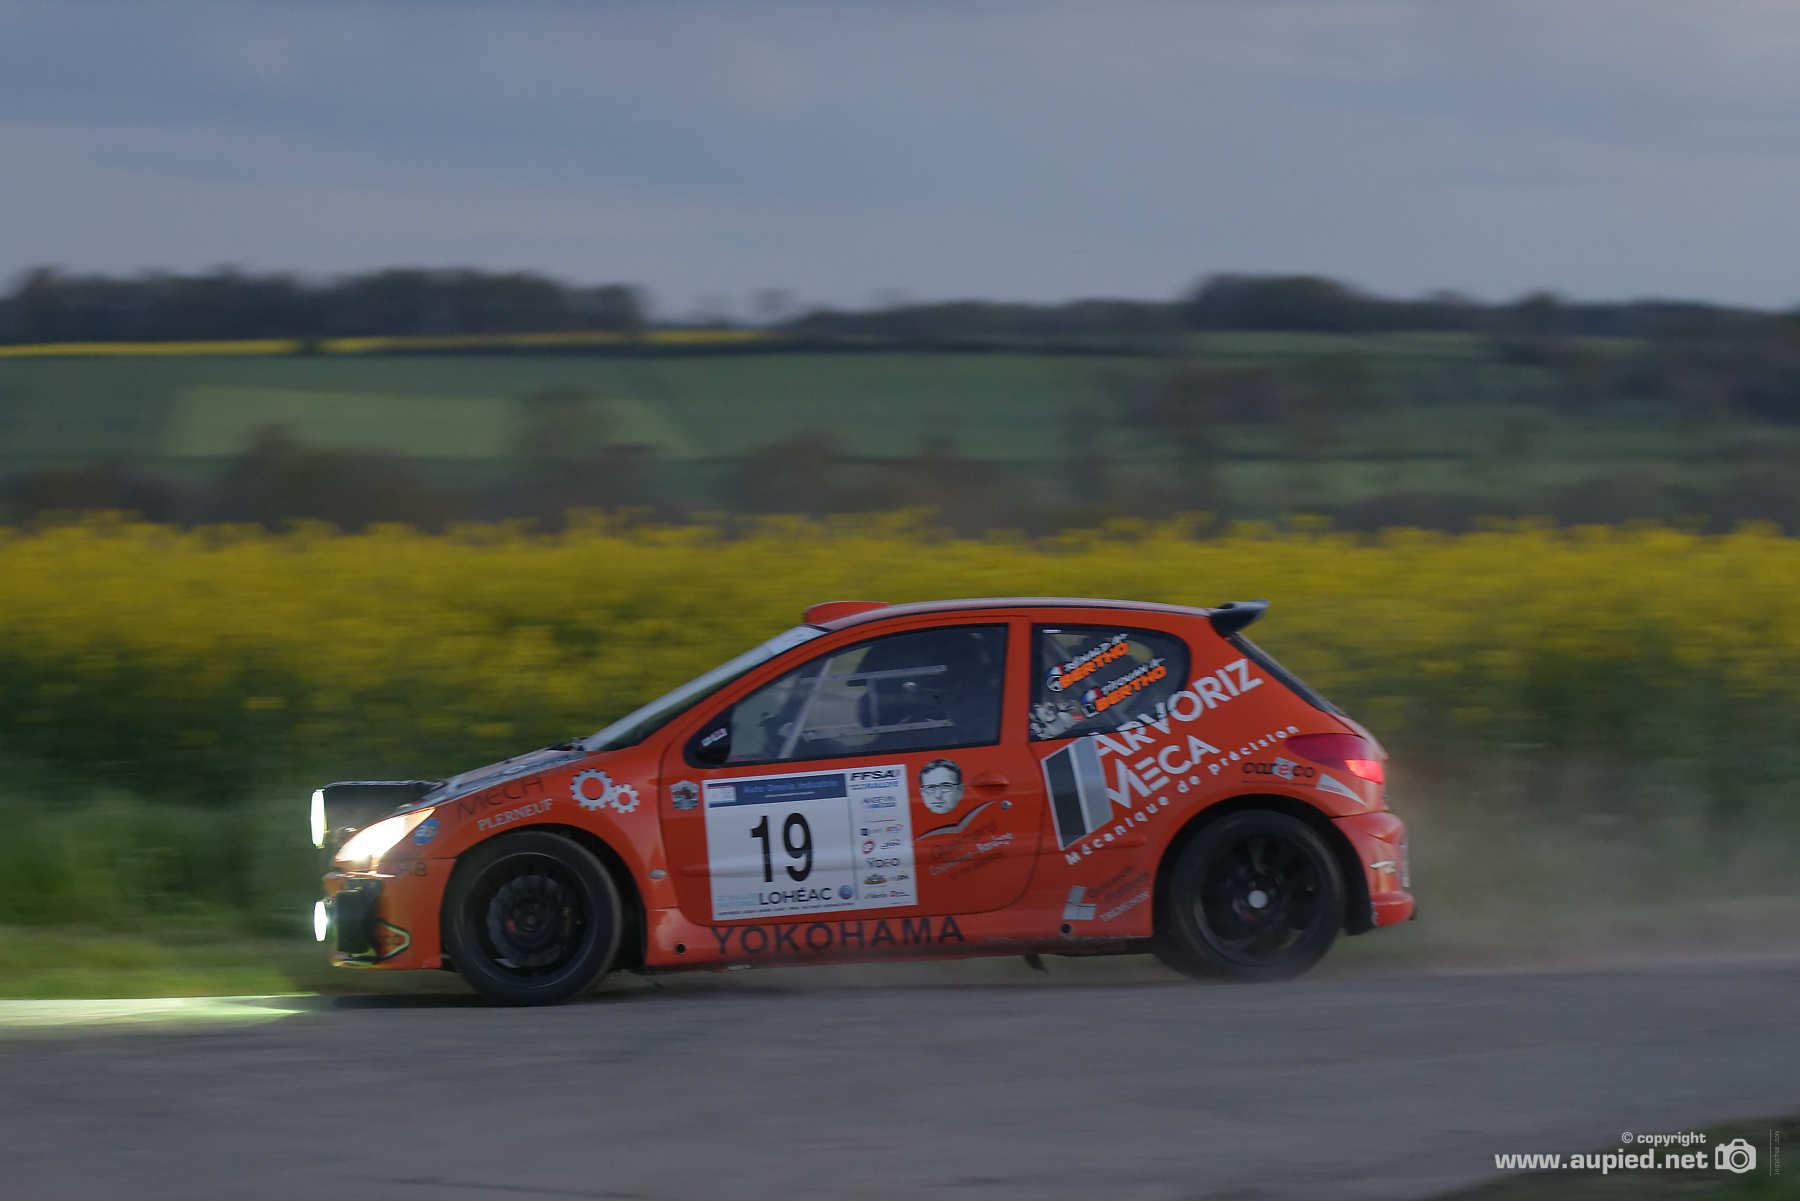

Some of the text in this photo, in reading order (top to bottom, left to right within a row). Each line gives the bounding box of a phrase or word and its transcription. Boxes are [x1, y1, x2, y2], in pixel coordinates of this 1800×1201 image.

[1058, 642, 1129, 689] BERTHO
[1094, 665, 1167, 712] BERTHO
[1087, 658, 1264, 757] ARVORIZ
[850, 769, 896, 781] FFSA
[1105, 733, 1221, 809] MECA
[476, 798, 553, 832] PLERNEUF
[1065, 796, 1170, 865] Mécanique
[1176, 775, 1201, 793] de
[1207, 725, 1300, 775] précision
[750, 812, 814, 882] 19
[710, 915, 965, 954] YOKOHAMA
